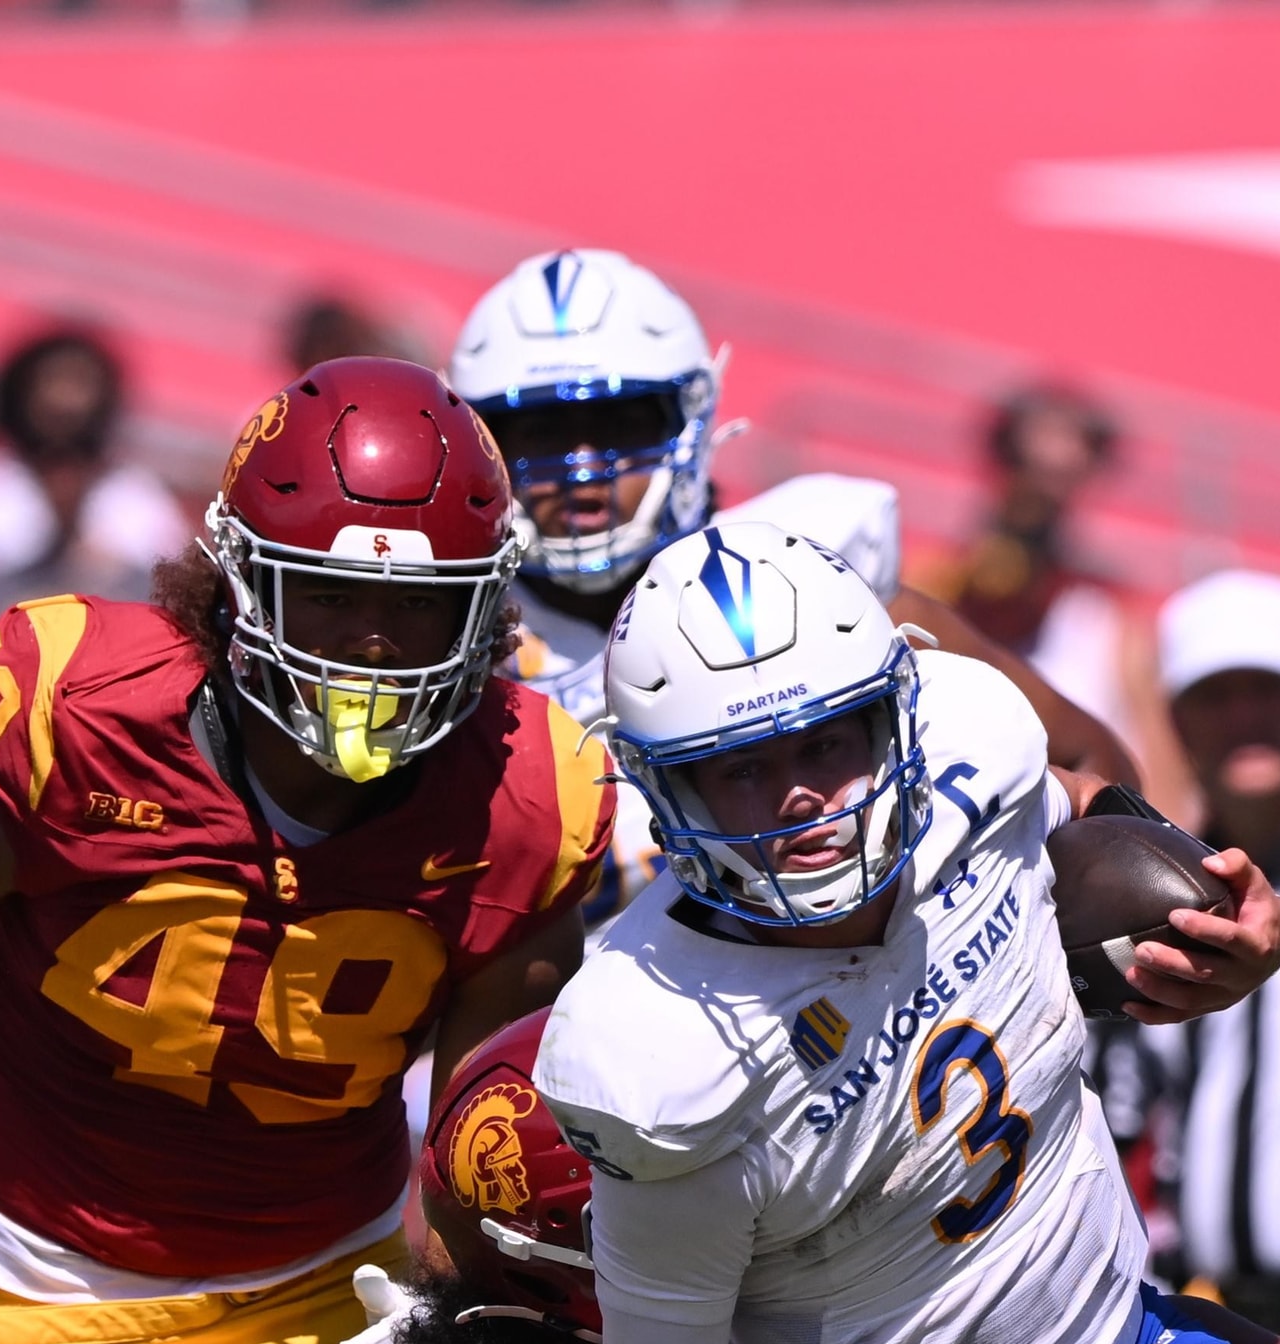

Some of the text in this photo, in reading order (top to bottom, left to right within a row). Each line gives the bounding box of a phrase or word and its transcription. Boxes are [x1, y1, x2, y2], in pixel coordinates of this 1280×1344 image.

[726, 683, 808, 717] SPARTANS
[40, 872, 448, 1124] 49
[805, 1057, 881, 1135] SAN
[879, 963, 957, 1066] JOSÉ
[953, 886, 1020, 983] STATE
[911, 1018, 1034, 1244] 3
